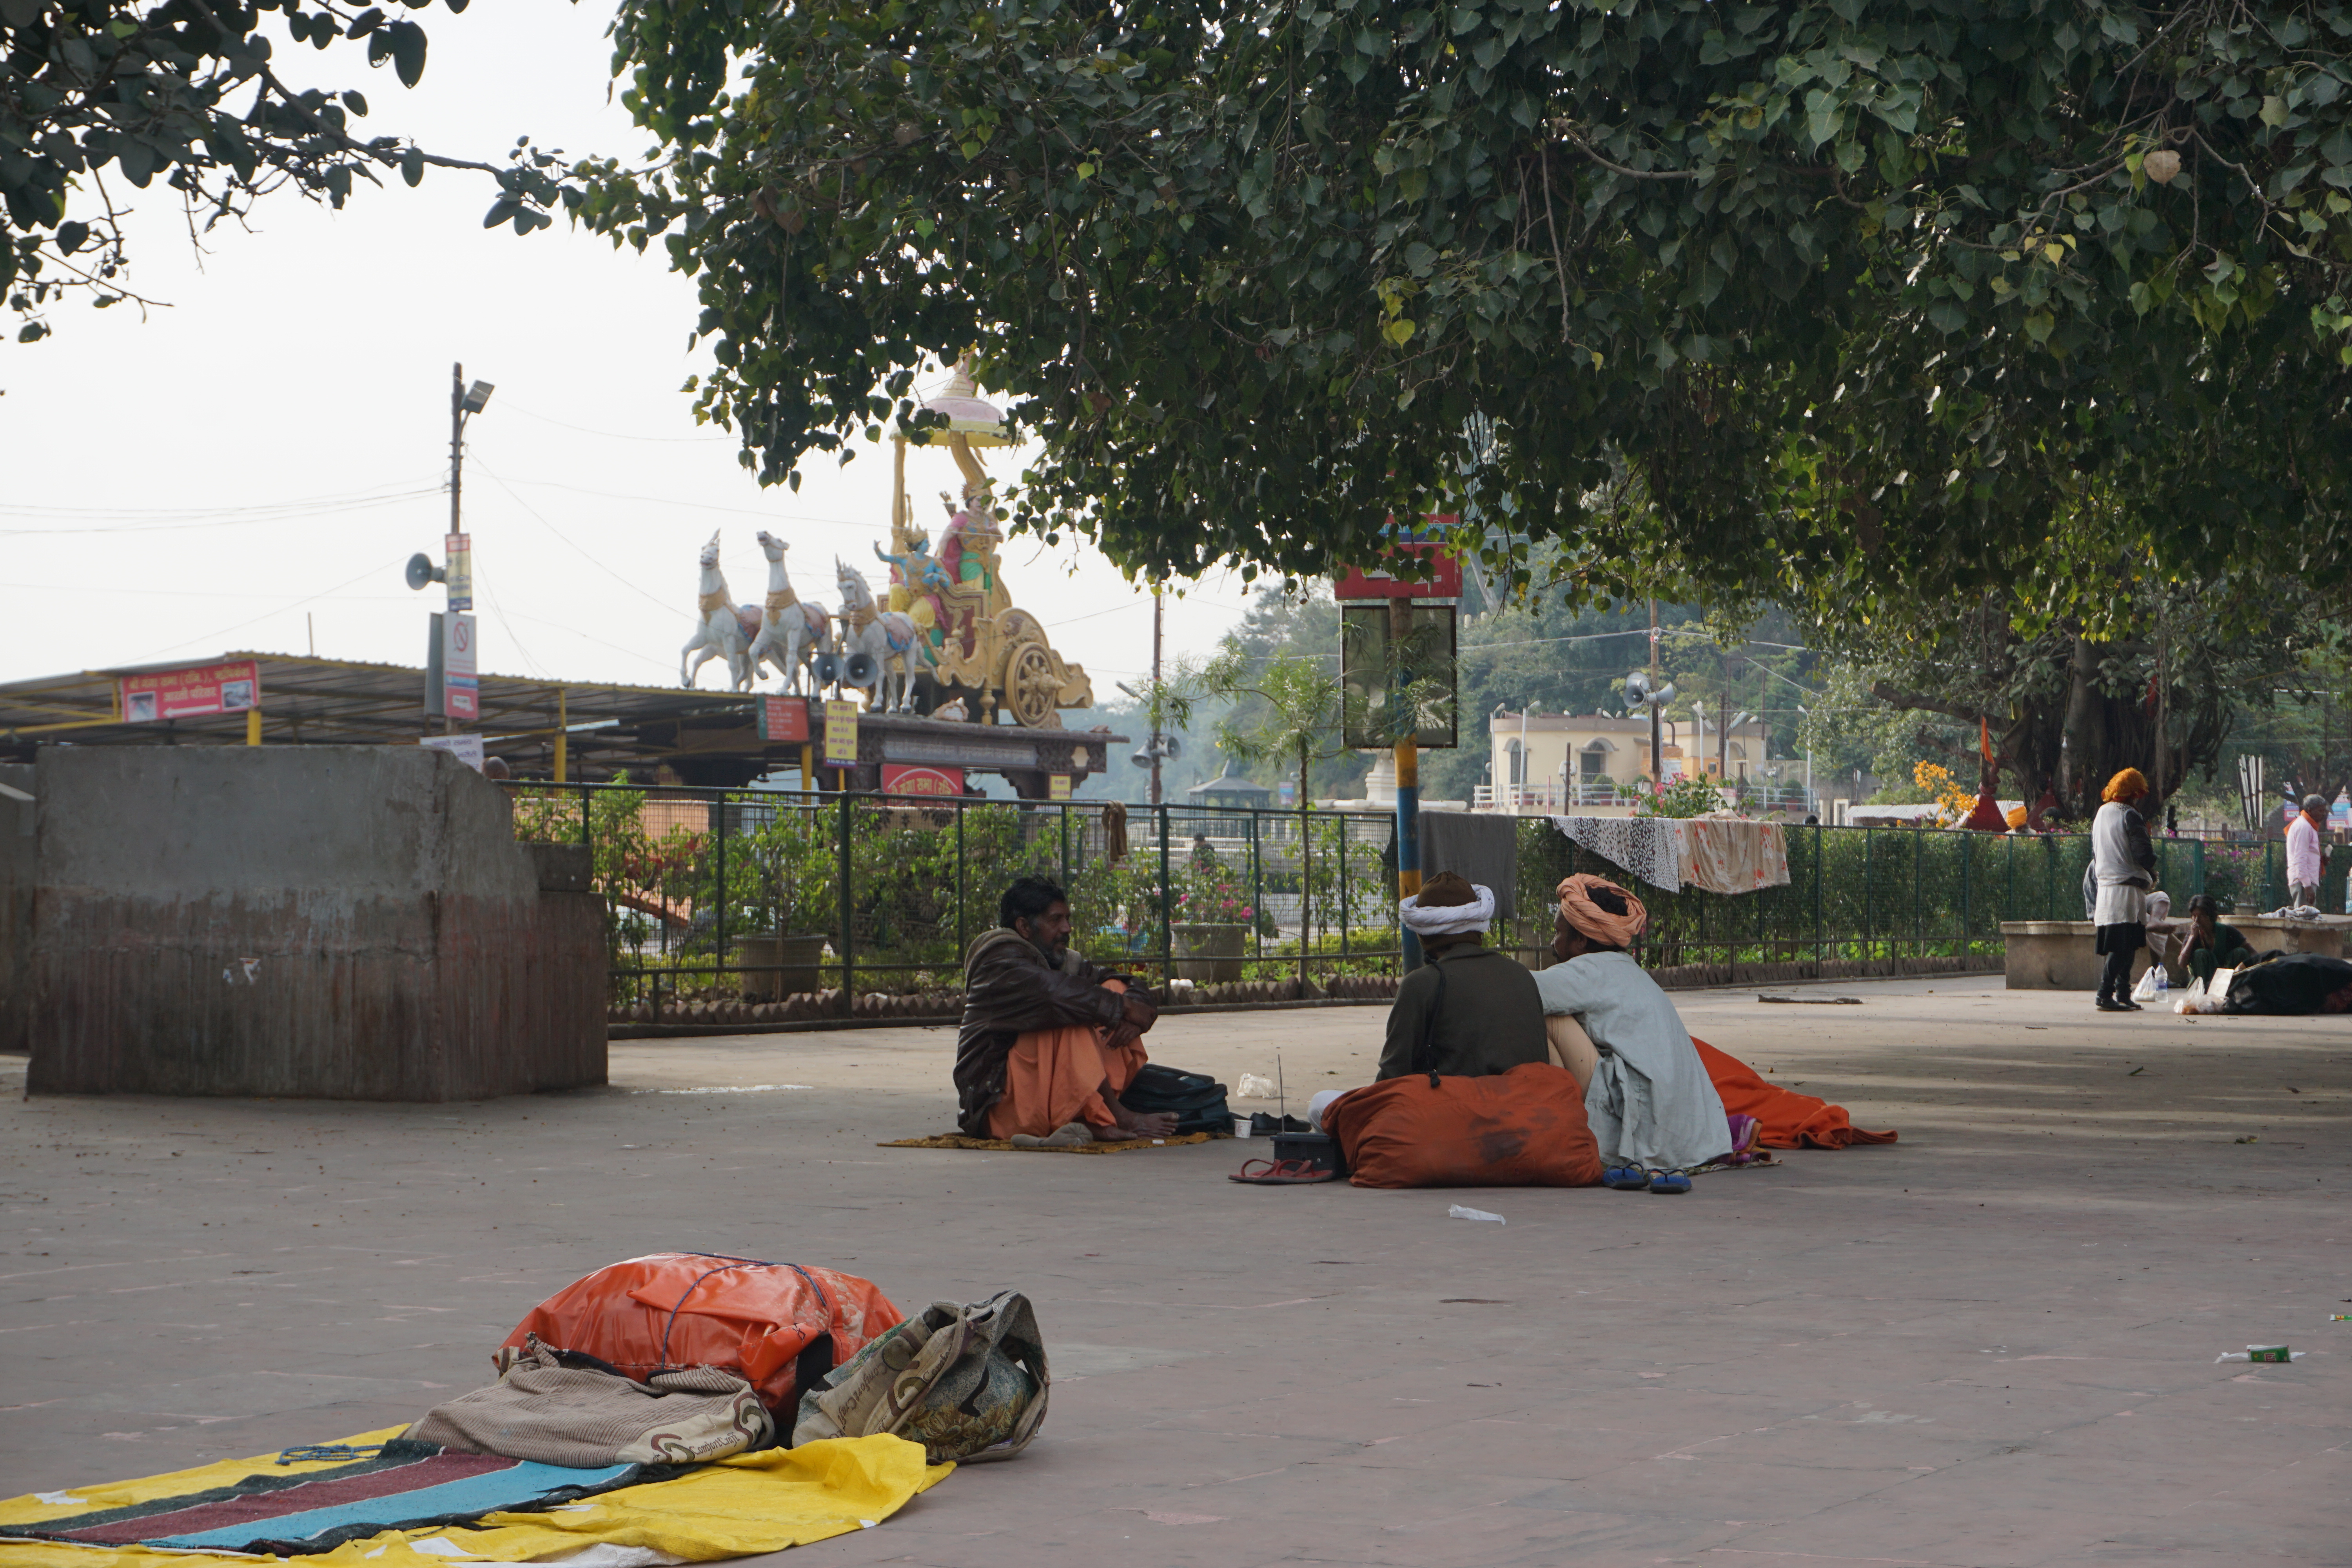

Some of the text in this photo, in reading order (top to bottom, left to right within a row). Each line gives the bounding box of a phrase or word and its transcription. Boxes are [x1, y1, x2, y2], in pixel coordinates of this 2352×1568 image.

[916, 777, 933, 791] सभा
[837, 1364, 888, 1426] ComfortCraft
[689, 1432, 740, 1456] ComfortCraft
